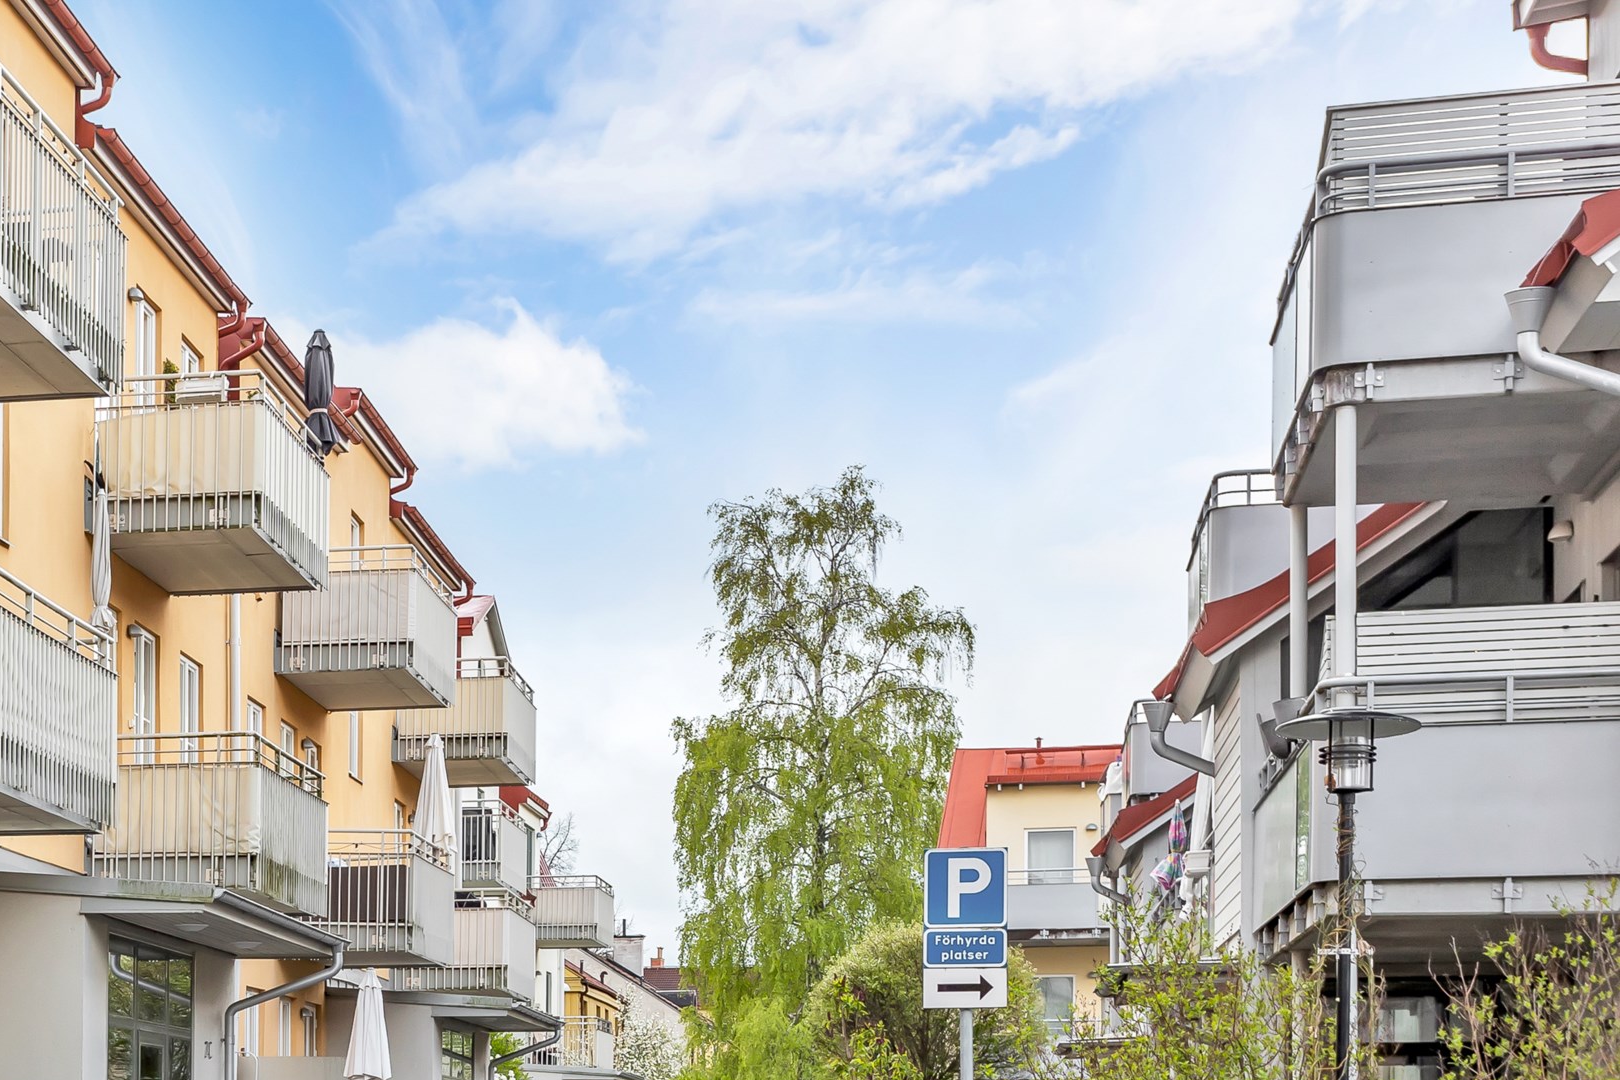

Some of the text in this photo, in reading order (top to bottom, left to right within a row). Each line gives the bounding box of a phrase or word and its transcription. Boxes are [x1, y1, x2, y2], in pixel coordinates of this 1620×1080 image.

[947, 858, 991, 918] P
[935, 935, 995, 947] Förhyrda
[941, 950, 989, 962] platser
